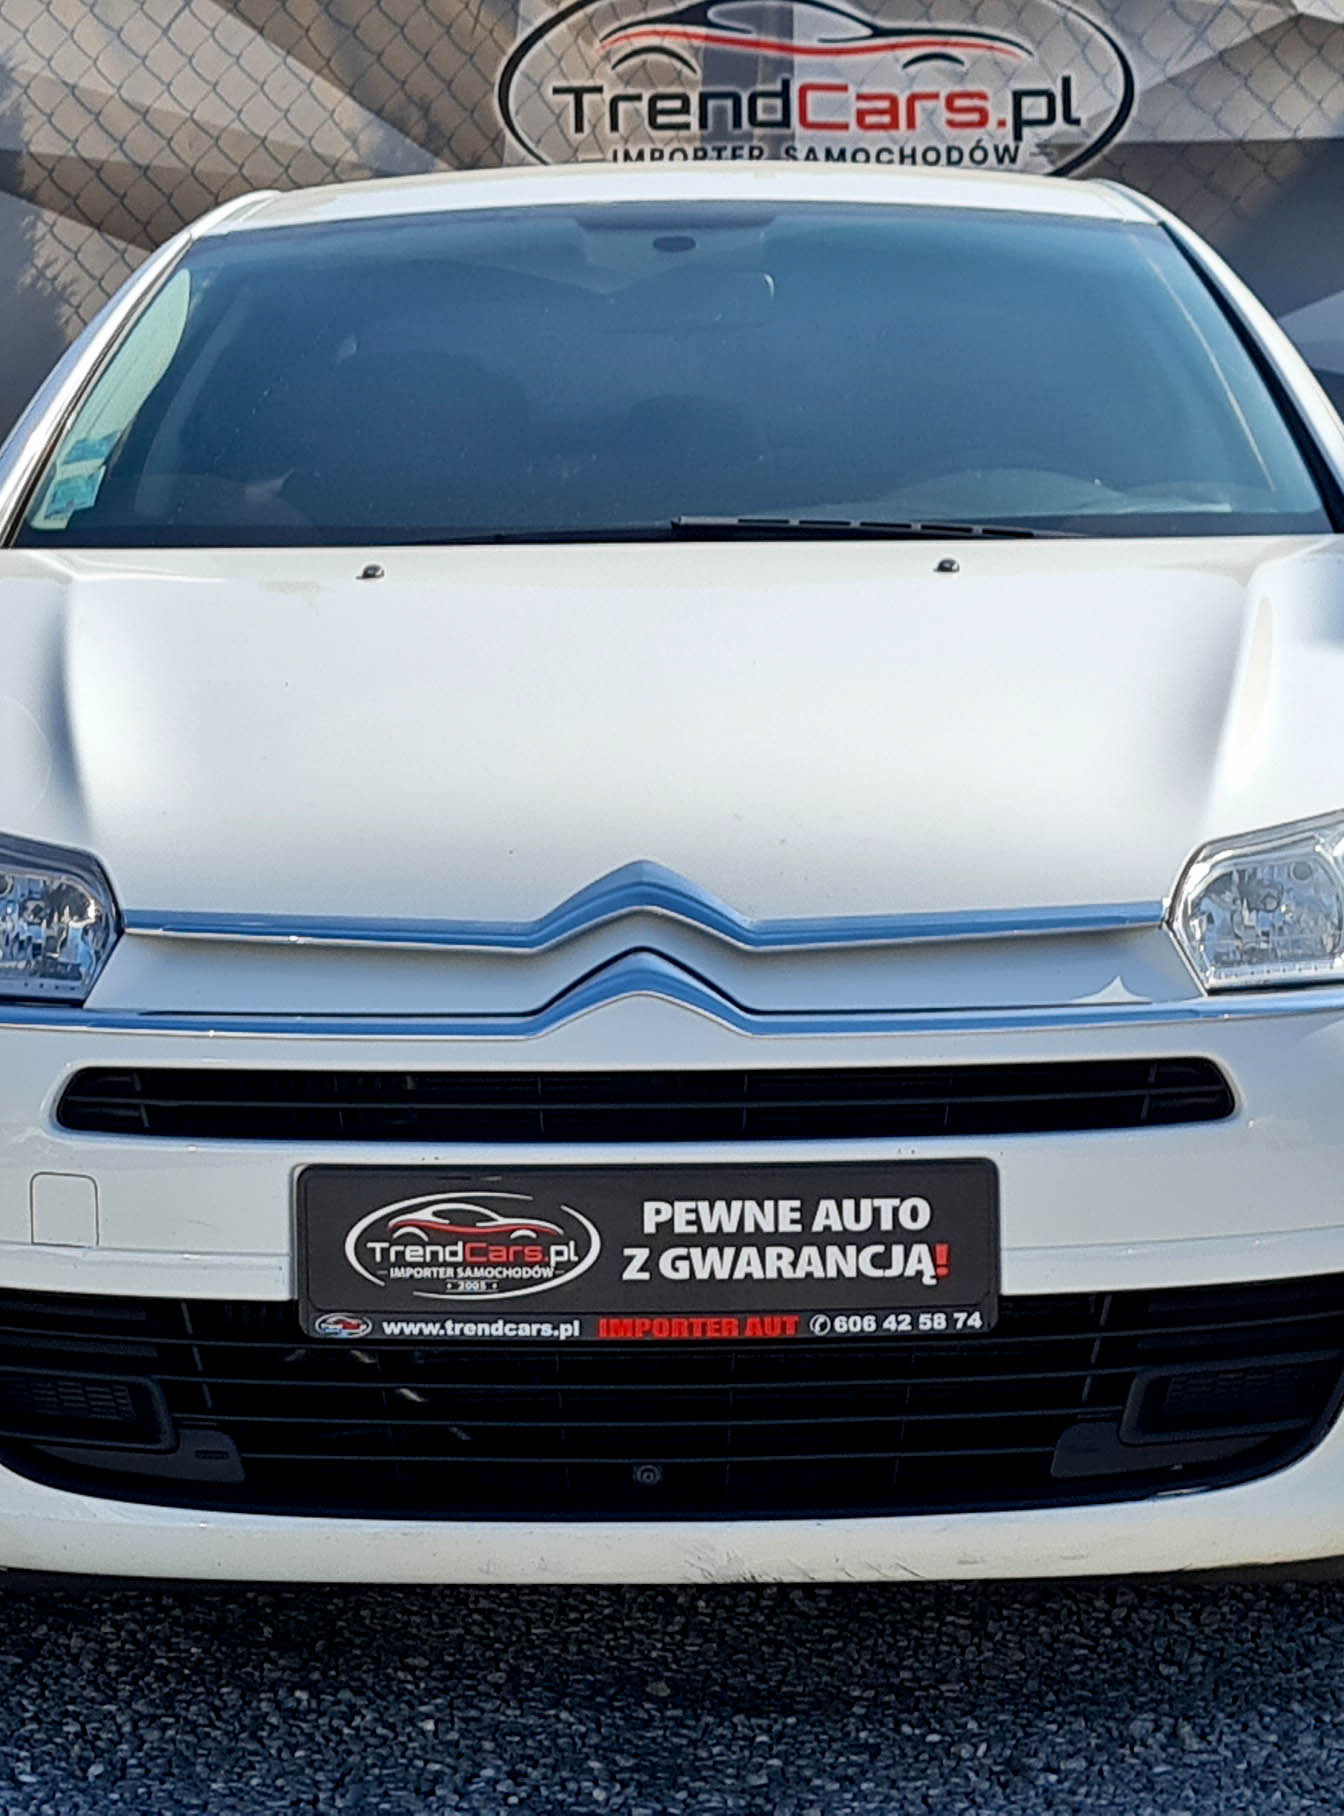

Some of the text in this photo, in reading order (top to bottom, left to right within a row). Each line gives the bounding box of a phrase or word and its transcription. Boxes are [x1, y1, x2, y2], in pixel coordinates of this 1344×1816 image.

[553, 75, 1082, 141] TrendCars.pl
[785, 138, 1020, 165] SAMOCHODÓW
[643, 1197, 931, 1234] PEWNE AUTO
[366, 1241, 579, 1269] TrendCars.pl
[622, 1242, 950, 1286] Z GWARANCJĄ!
[390, 1264, 555, 1279] IMPORTER SAMOCHODÓW
[458, 1281, 487, 1291] 2005
[382, 1312, 983, 1340] www.trendcars.pl IMPORTER AUT 606 42 58 74
